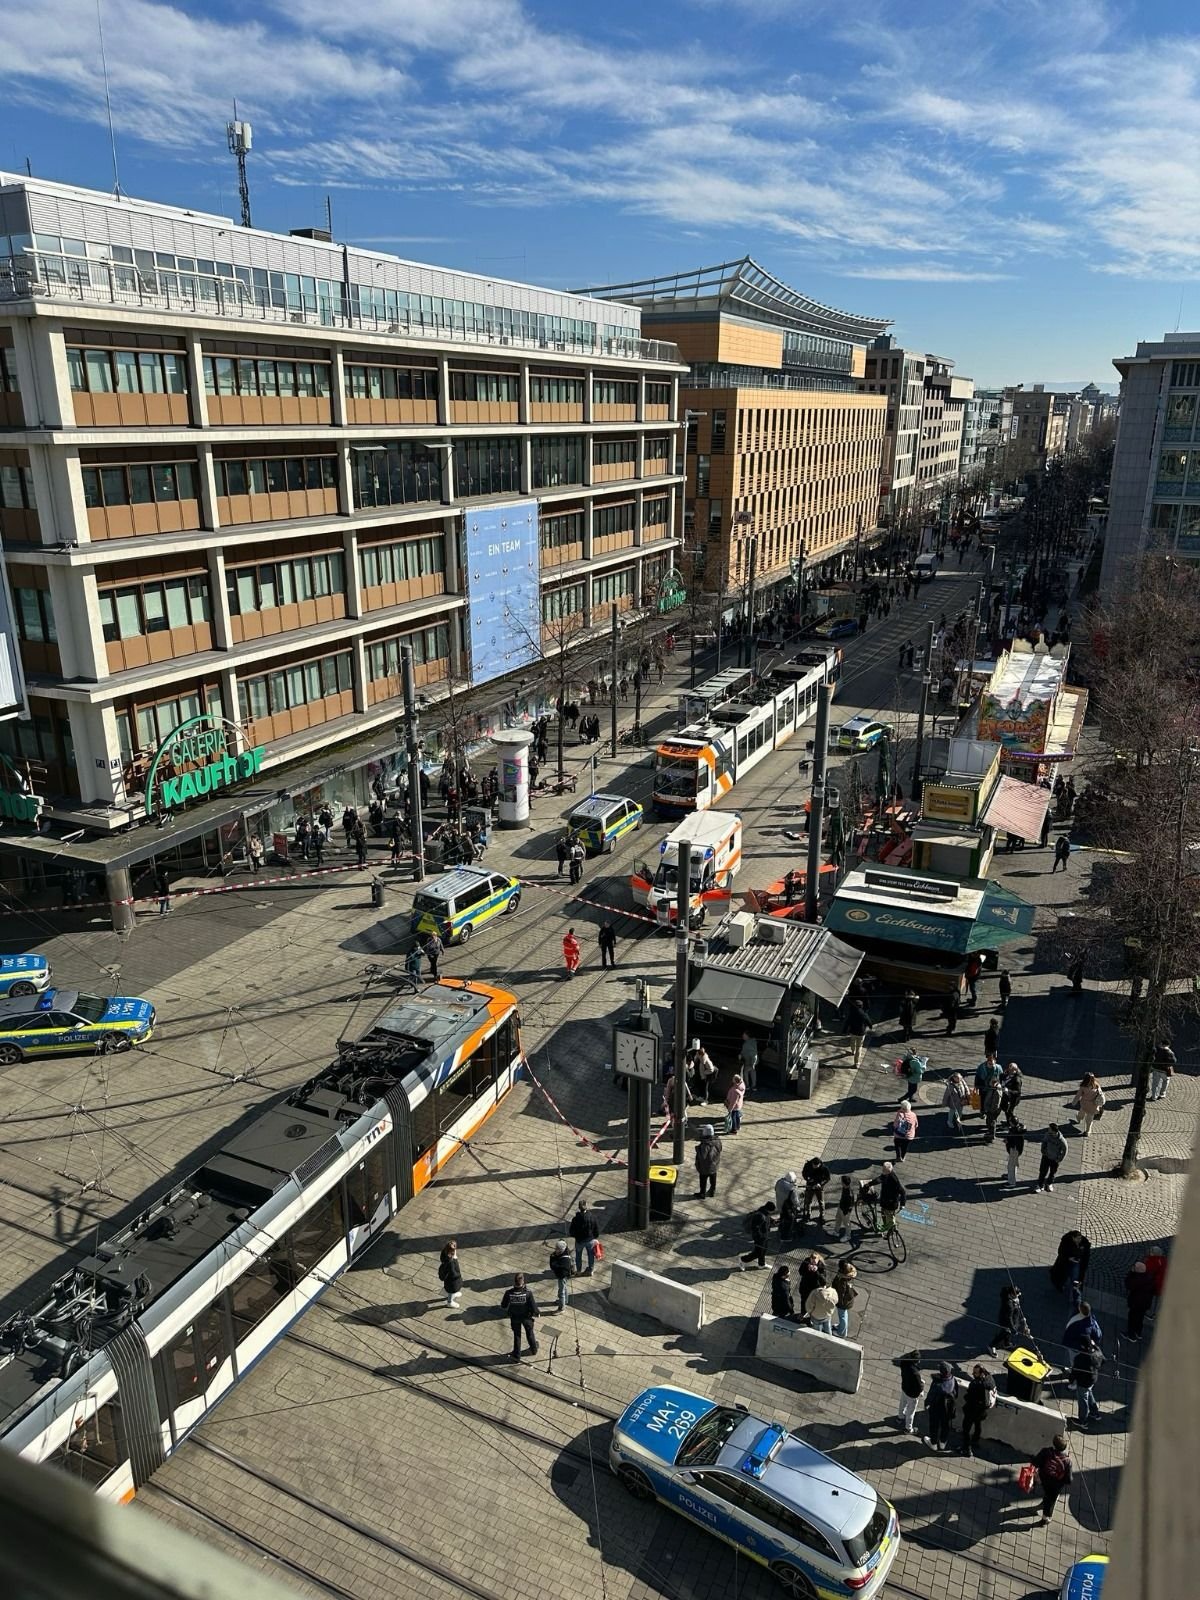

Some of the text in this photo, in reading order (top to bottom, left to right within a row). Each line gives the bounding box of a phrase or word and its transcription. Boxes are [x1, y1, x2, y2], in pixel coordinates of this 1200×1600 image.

[488, 544, 500, 556] EIN
[502, 540, 521, 553] TEAM
[171, 728, 227, 767] GALERIA
[875, 913, 946, 934] Eichbaum
[58, 1035, 90, 1043] POLIZEI
[628, 1393, 657, 1423] POLIZEI
[667, 1410, 696, 1441] 269
[679, 1494, 718, 1524] POLIZEI
